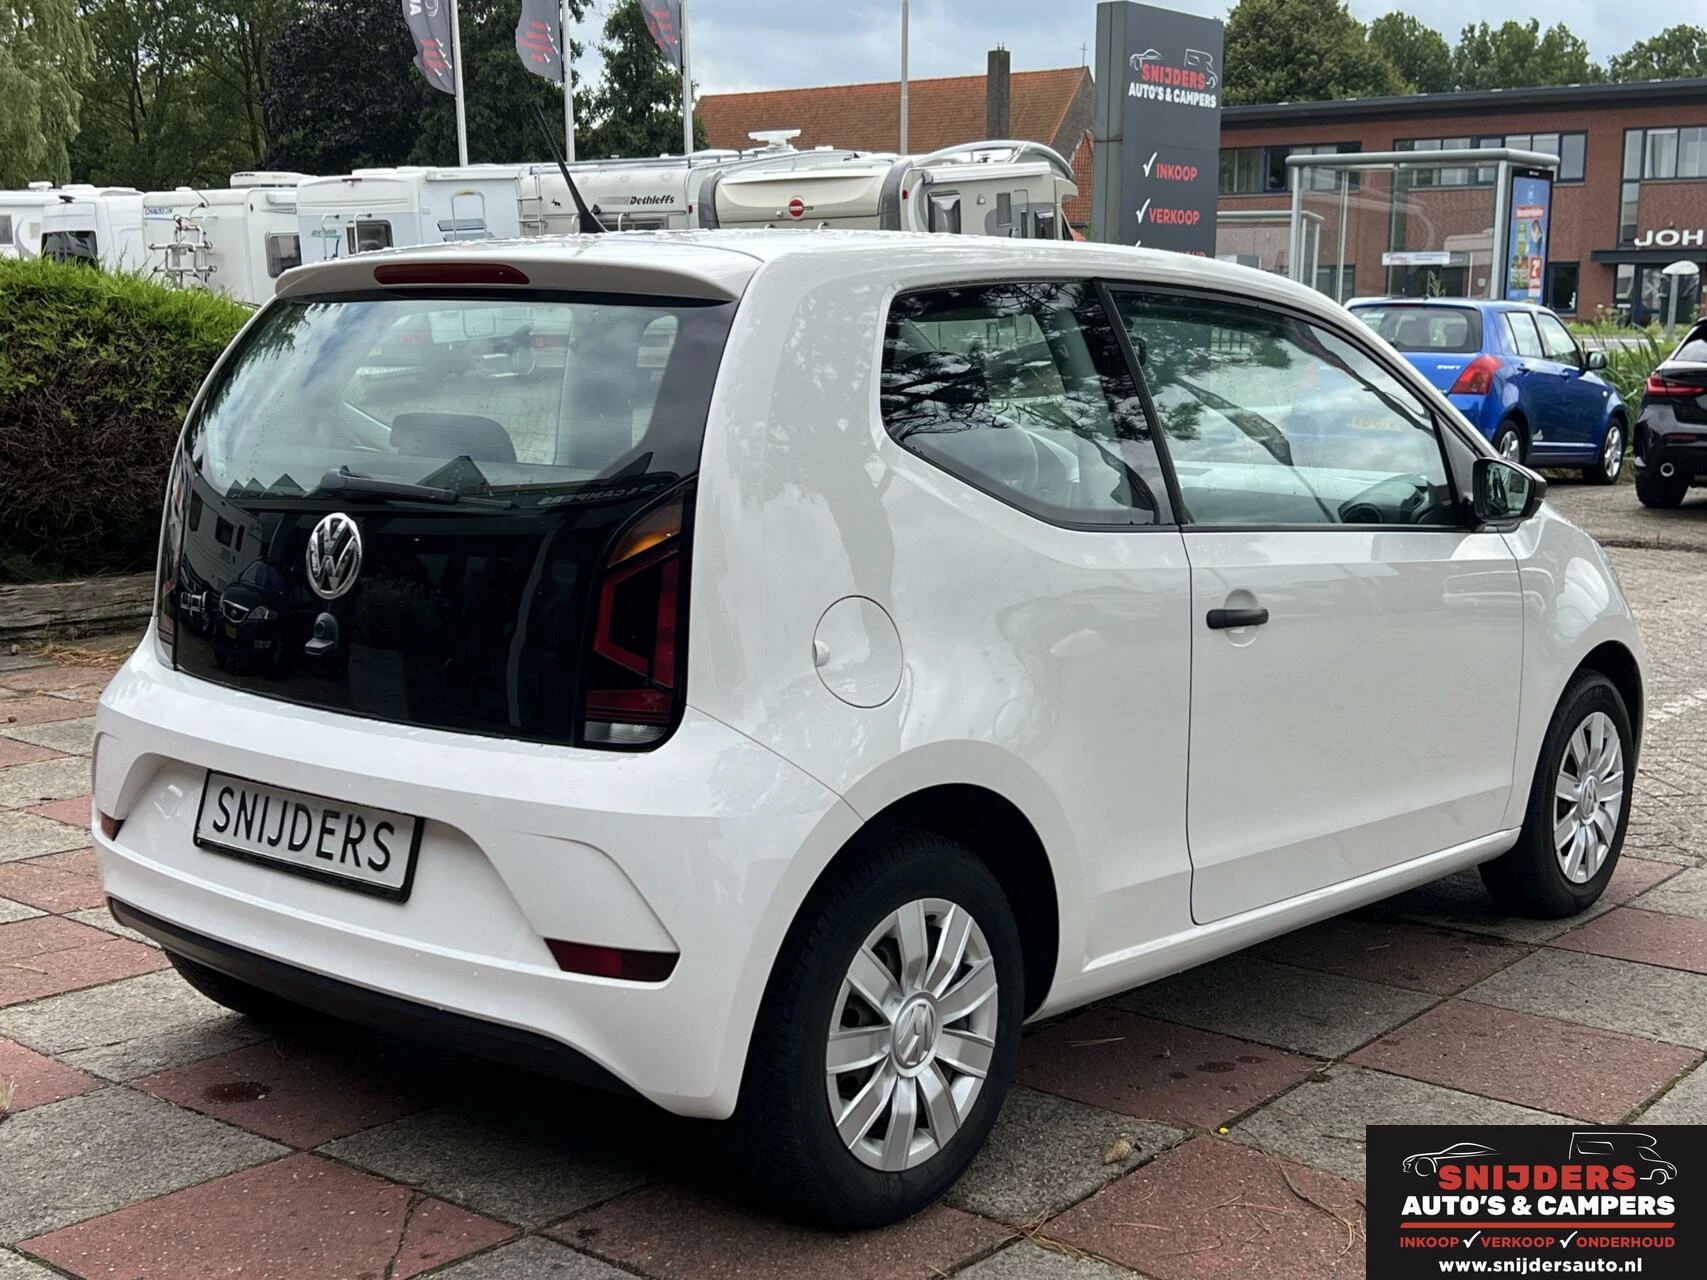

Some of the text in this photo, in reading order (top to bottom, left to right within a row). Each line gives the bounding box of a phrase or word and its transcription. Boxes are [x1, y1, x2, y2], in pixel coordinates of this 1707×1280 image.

[1142, 63, 1206, 90] SNIJDERS
[1128, 82, 1217, 109] AUTO'S & CAMPERS
[1156, 163, 1197, 181] INKOOP
[630, 194, 675, 205] Dethleffs
[1148, 207, 1200, 225] VERKOOP
[212, 786, 395, 872] SNIJDERS
